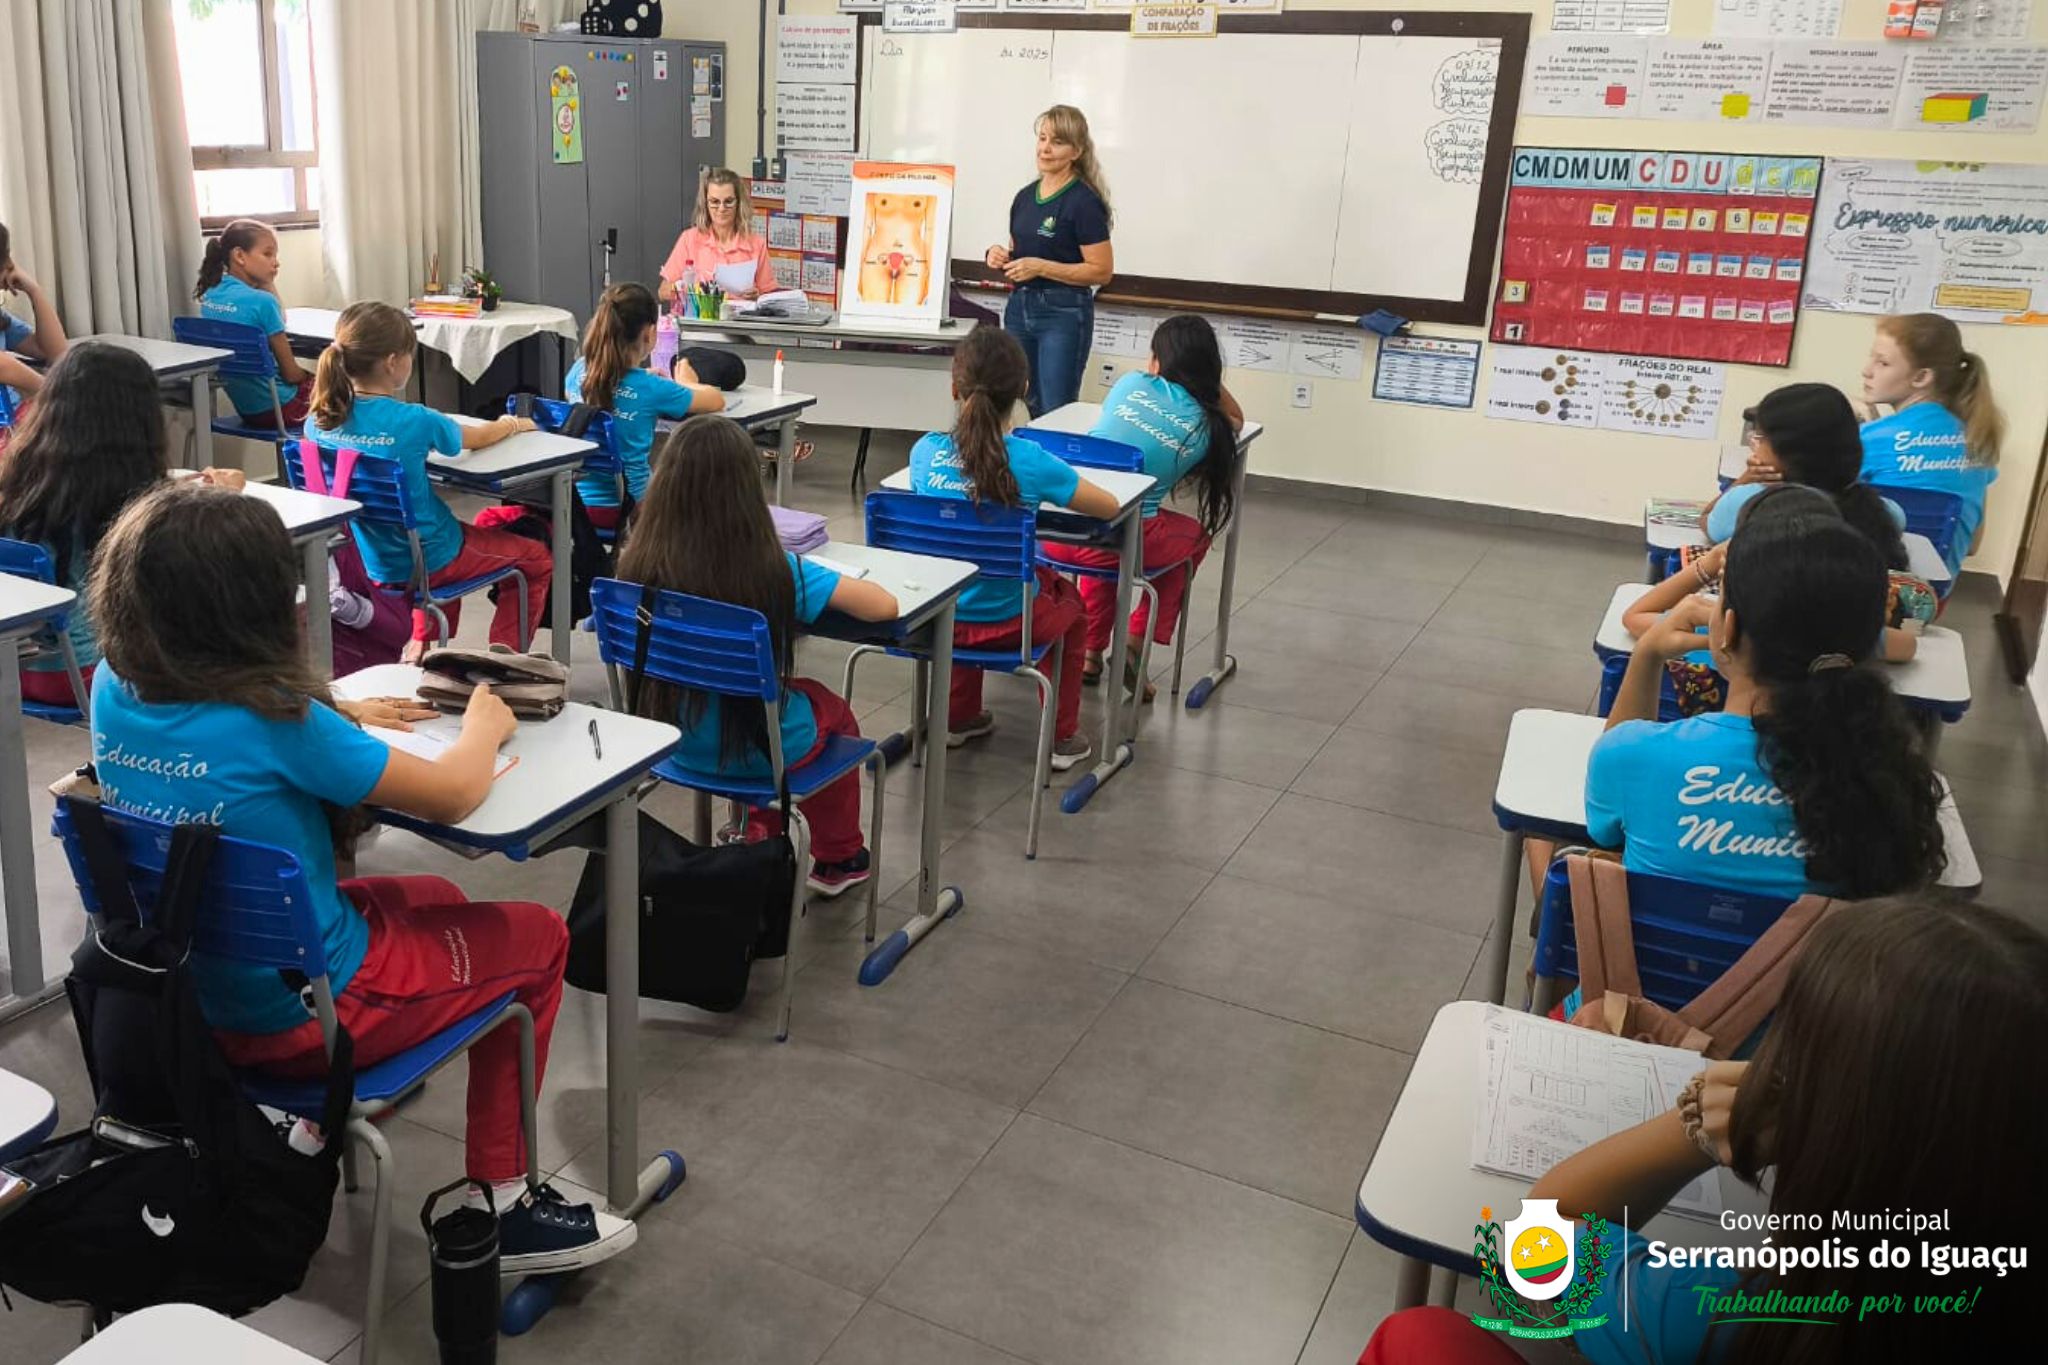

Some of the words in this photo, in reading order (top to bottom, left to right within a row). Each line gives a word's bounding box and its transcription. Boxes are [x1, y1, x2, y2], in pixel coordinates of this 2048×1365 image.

[1515, 155, 1549, 178] CM
[1553, 156, 1588, 179] DM
[1594, 158, 1630, 180] UM
[1639, 158, 1657, 182] C
[1671, 159, 1689, 183] D
[1704, 160, 1722, 186] U
[1834, 202, 1939, 233] Expressão
[1511, 285, 1519, 297] 3
[1509, 326, 1520, 338] 1
[1619, 359, 1667, 371] FRAÇÕES
[1669, 363, 1684, 372] DO
[1687, 365, 1714, 376] REAL
[1896, 454, 1971, 474] Municip
[1678, 765, 1793, 805] Educ
[1678, 814, 1816, 858] Munic
